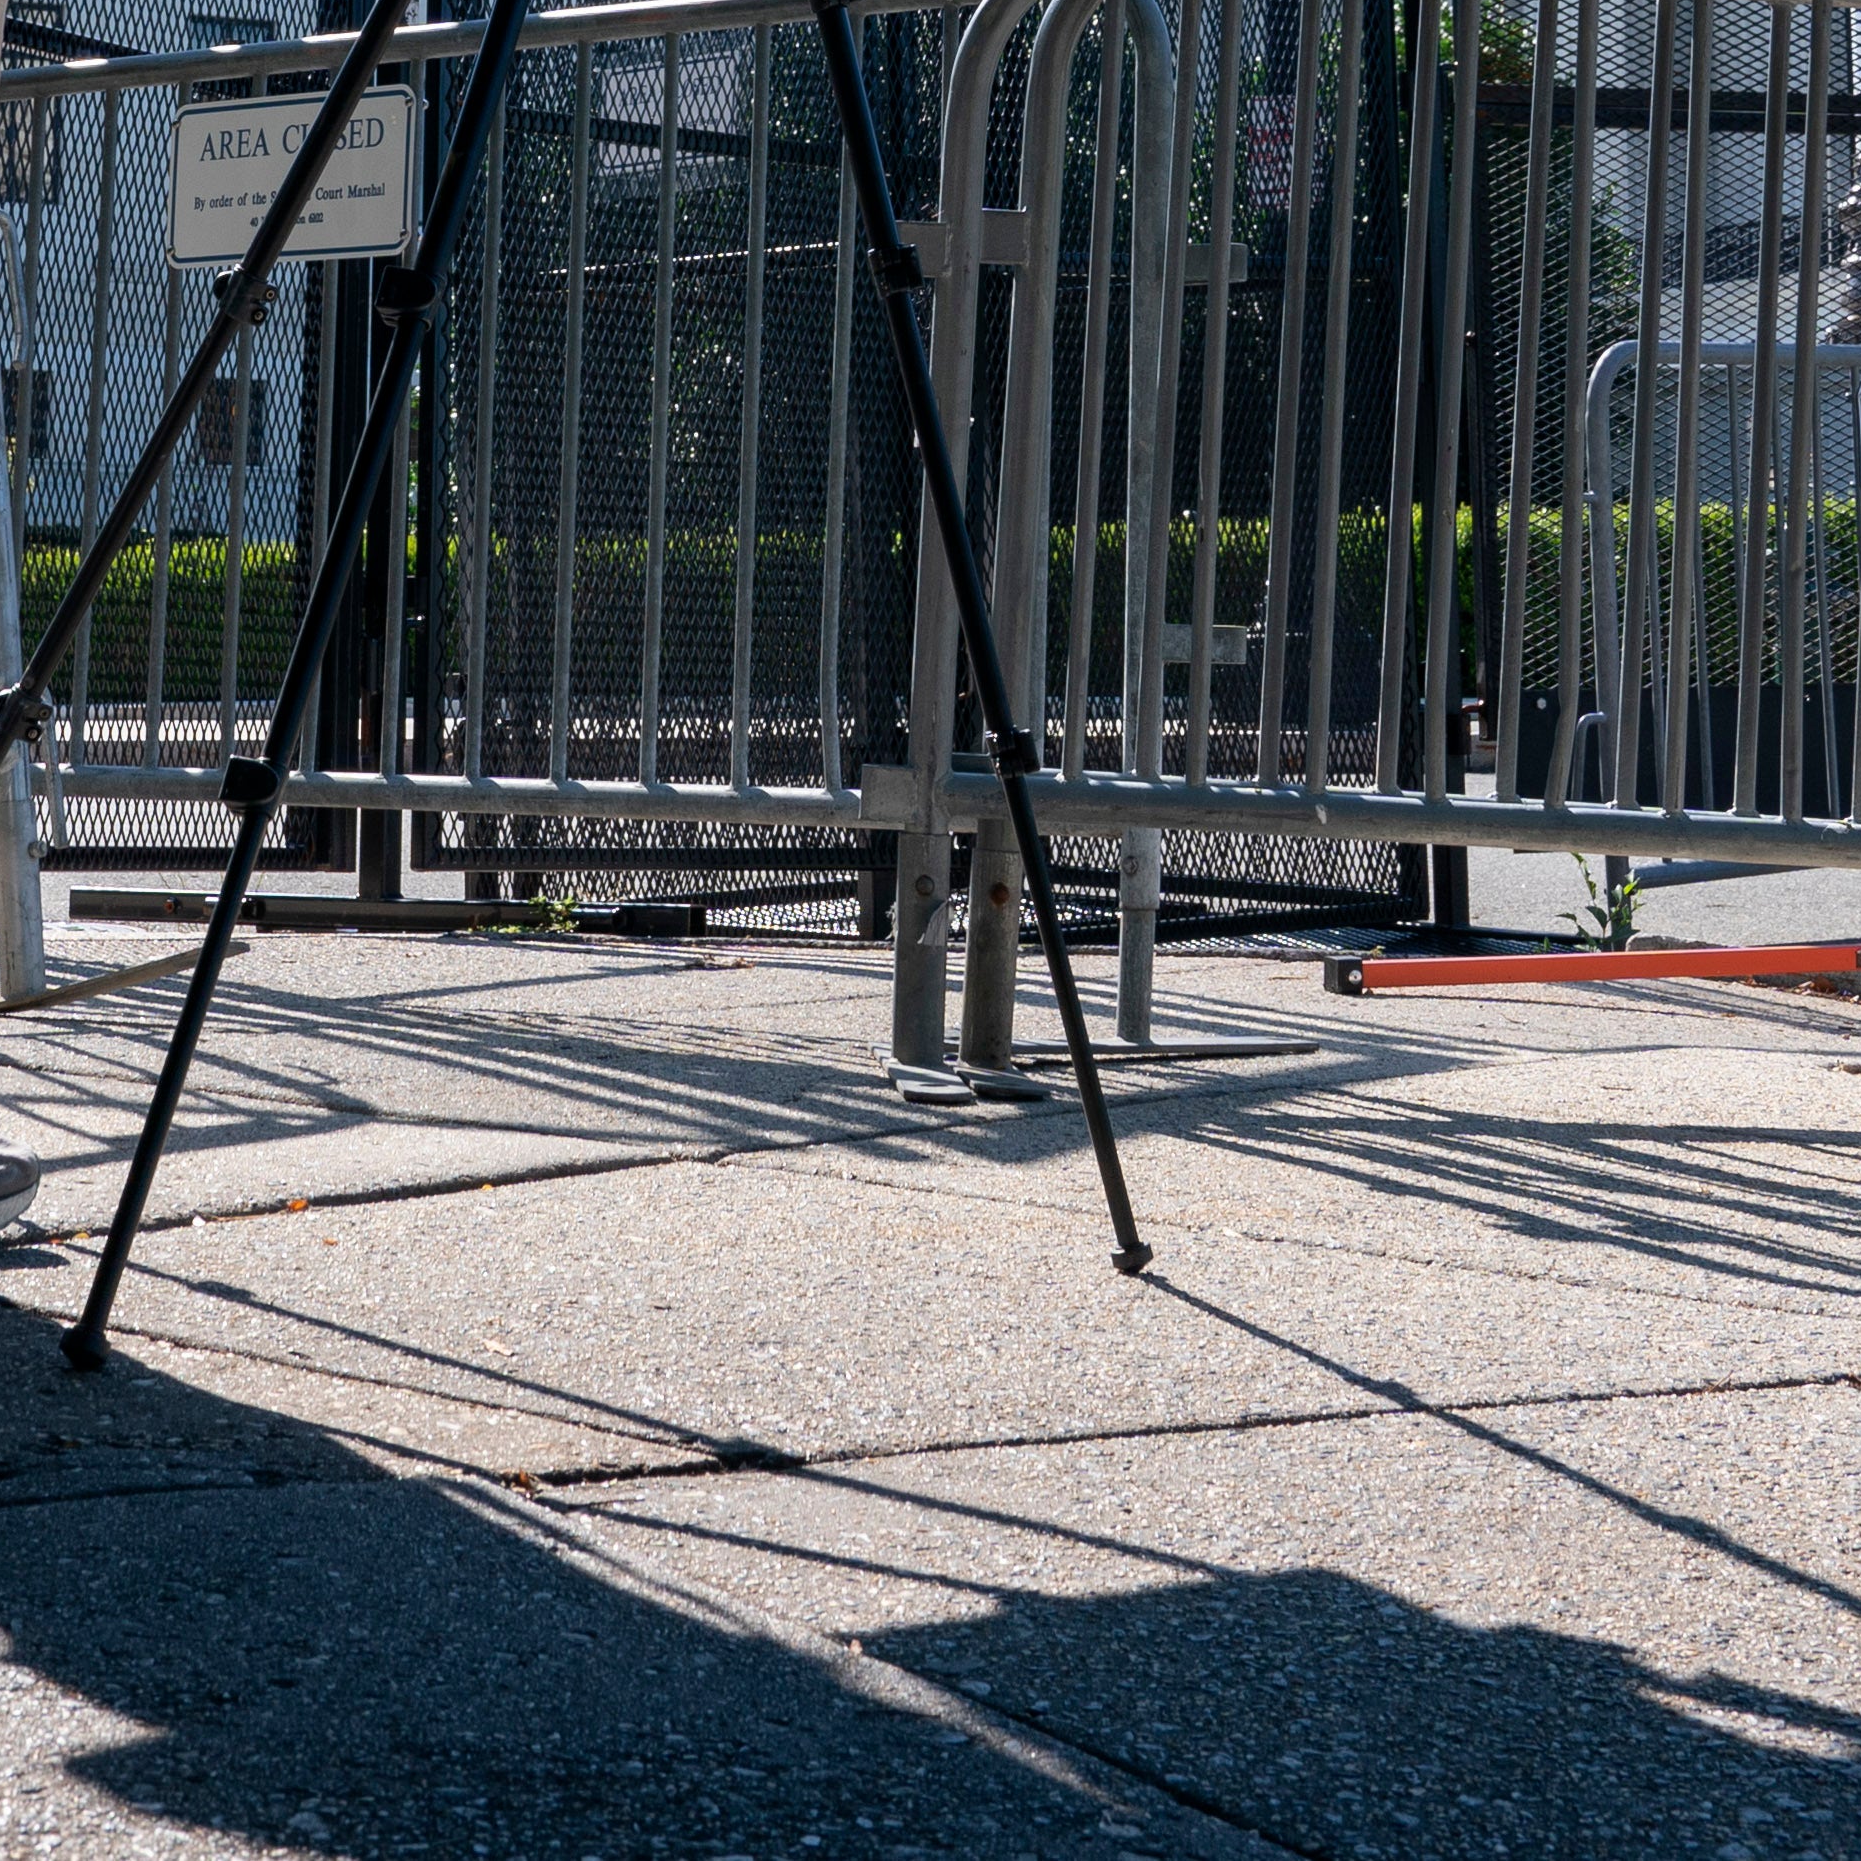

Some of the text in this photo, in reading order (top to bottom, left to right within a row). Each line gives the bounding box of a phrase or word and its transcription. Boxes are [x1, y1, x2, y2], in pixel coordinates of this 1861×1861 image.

[199, 117, 386, 162] AREA CSED
[194, 196, 206, 212] By
[209, 195, 234, 209] order
[237, 192, 249, 206] of
[252, 191, 267, 205] the
[315, 186, 344, 201] Court
[347, 182, 386, 199] Marshal
